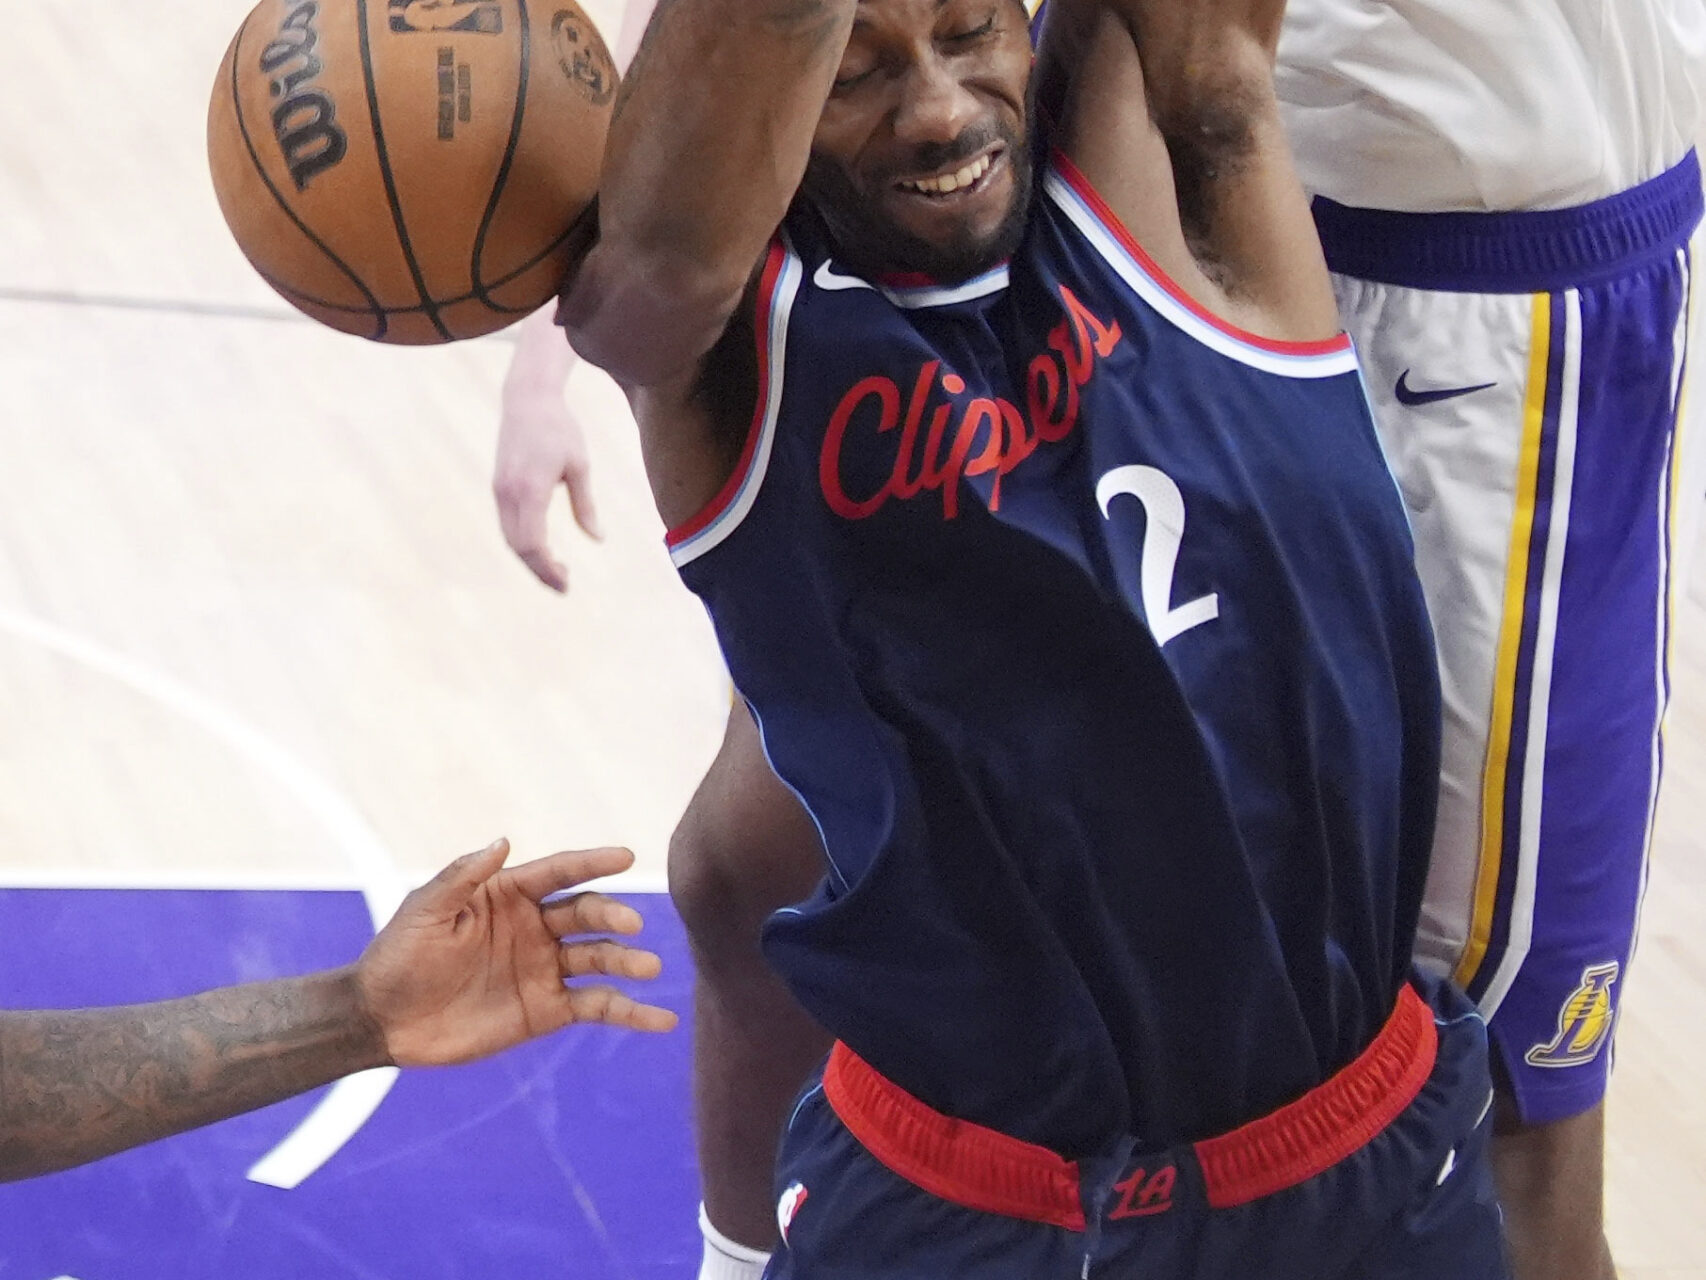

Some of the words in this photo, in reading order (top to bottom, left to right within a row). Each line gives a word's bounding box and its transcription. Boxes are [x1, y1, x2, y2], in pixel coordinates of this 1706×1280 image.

[818, 283, 1123, 521] Clippers
[1095, 464, 1219, 648] 2
[1108, 1164, 1178, 1221] LA
